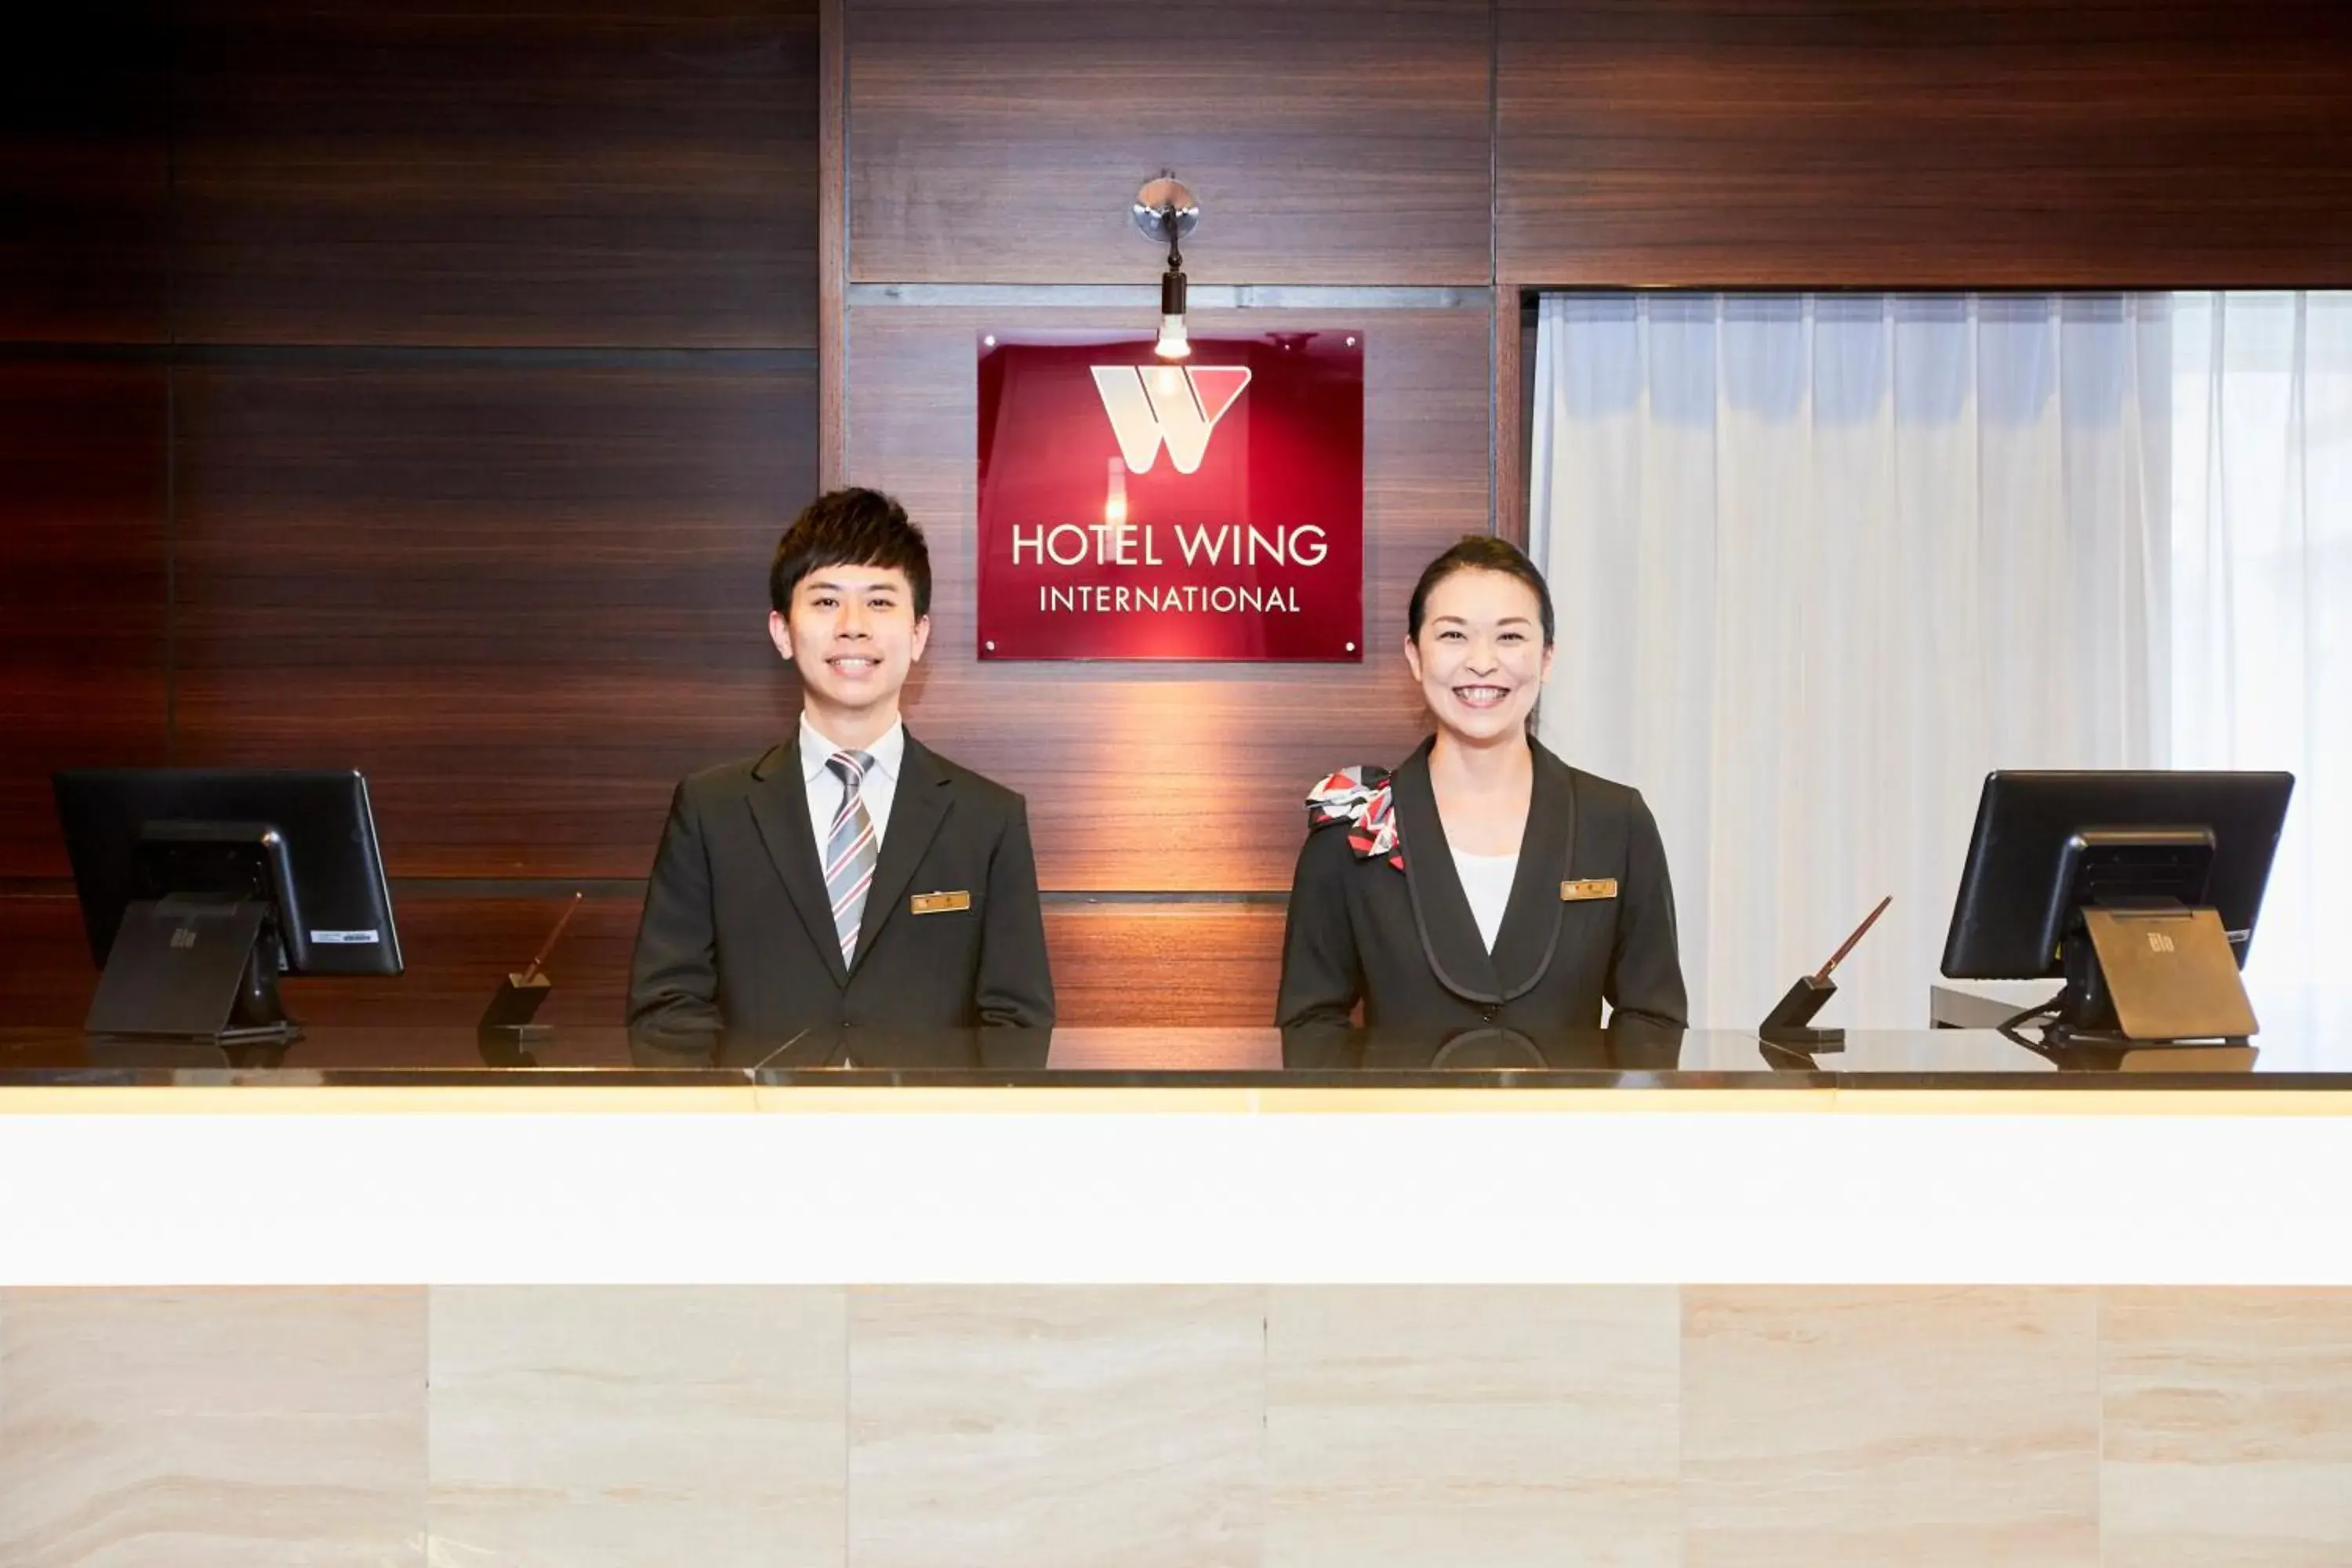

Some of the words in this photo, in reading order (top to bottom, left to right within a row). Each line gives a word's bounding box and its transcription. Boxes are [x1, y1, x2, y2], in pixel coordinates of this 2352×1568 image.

[1090, 365, 1252, 474] W
[1012, 524, 1162, 565] HOTEL
[1174, 524, 1327, 566] WING
[1040, 586, 1300, 612] INTERNATIONAL
